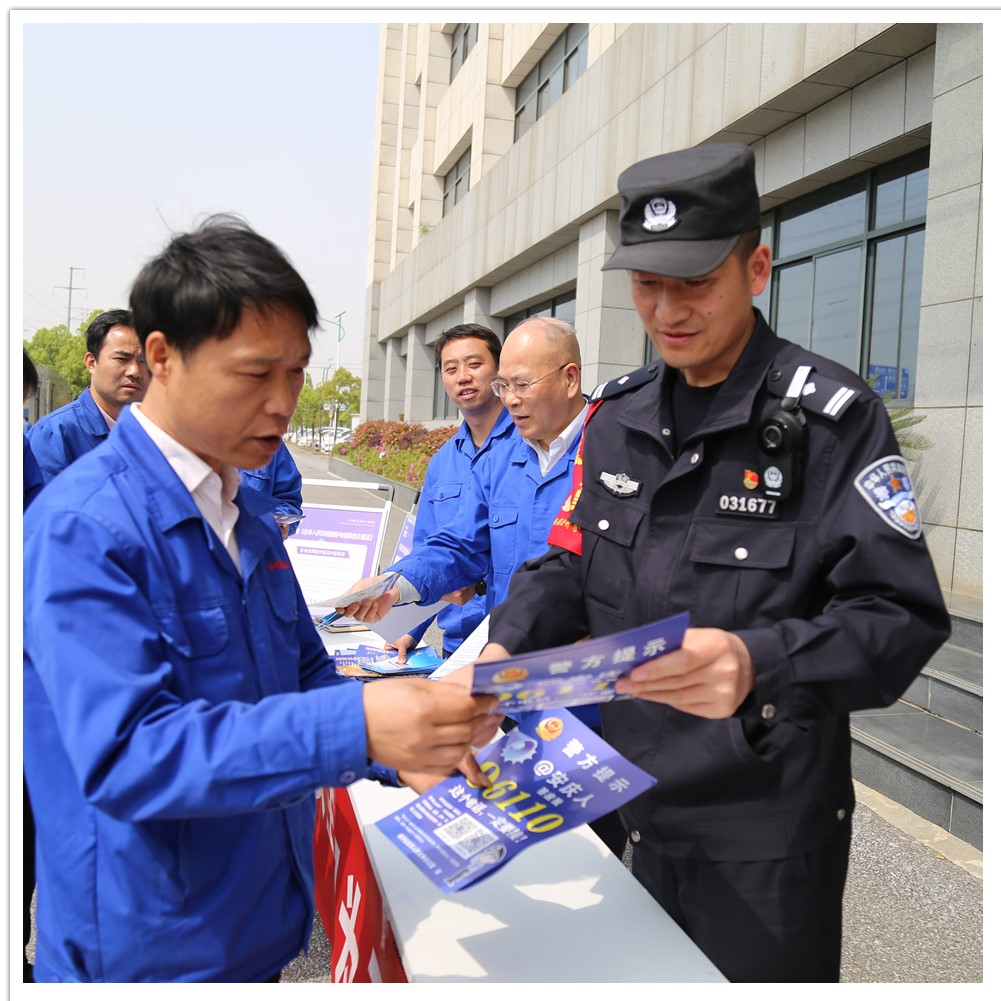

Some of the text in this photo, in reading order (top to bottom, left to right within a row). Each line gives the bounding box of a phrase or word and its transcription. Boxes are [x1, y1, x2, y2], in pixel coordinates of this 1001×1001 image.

[719, 494, 777, 515] 031677
[548, 637, 667, 675] 警方提示
[533, 759, 597, 809] @安庆人
[561, 738, 631, 794] 警方提示
[465, 761, 565, 833] 96110
